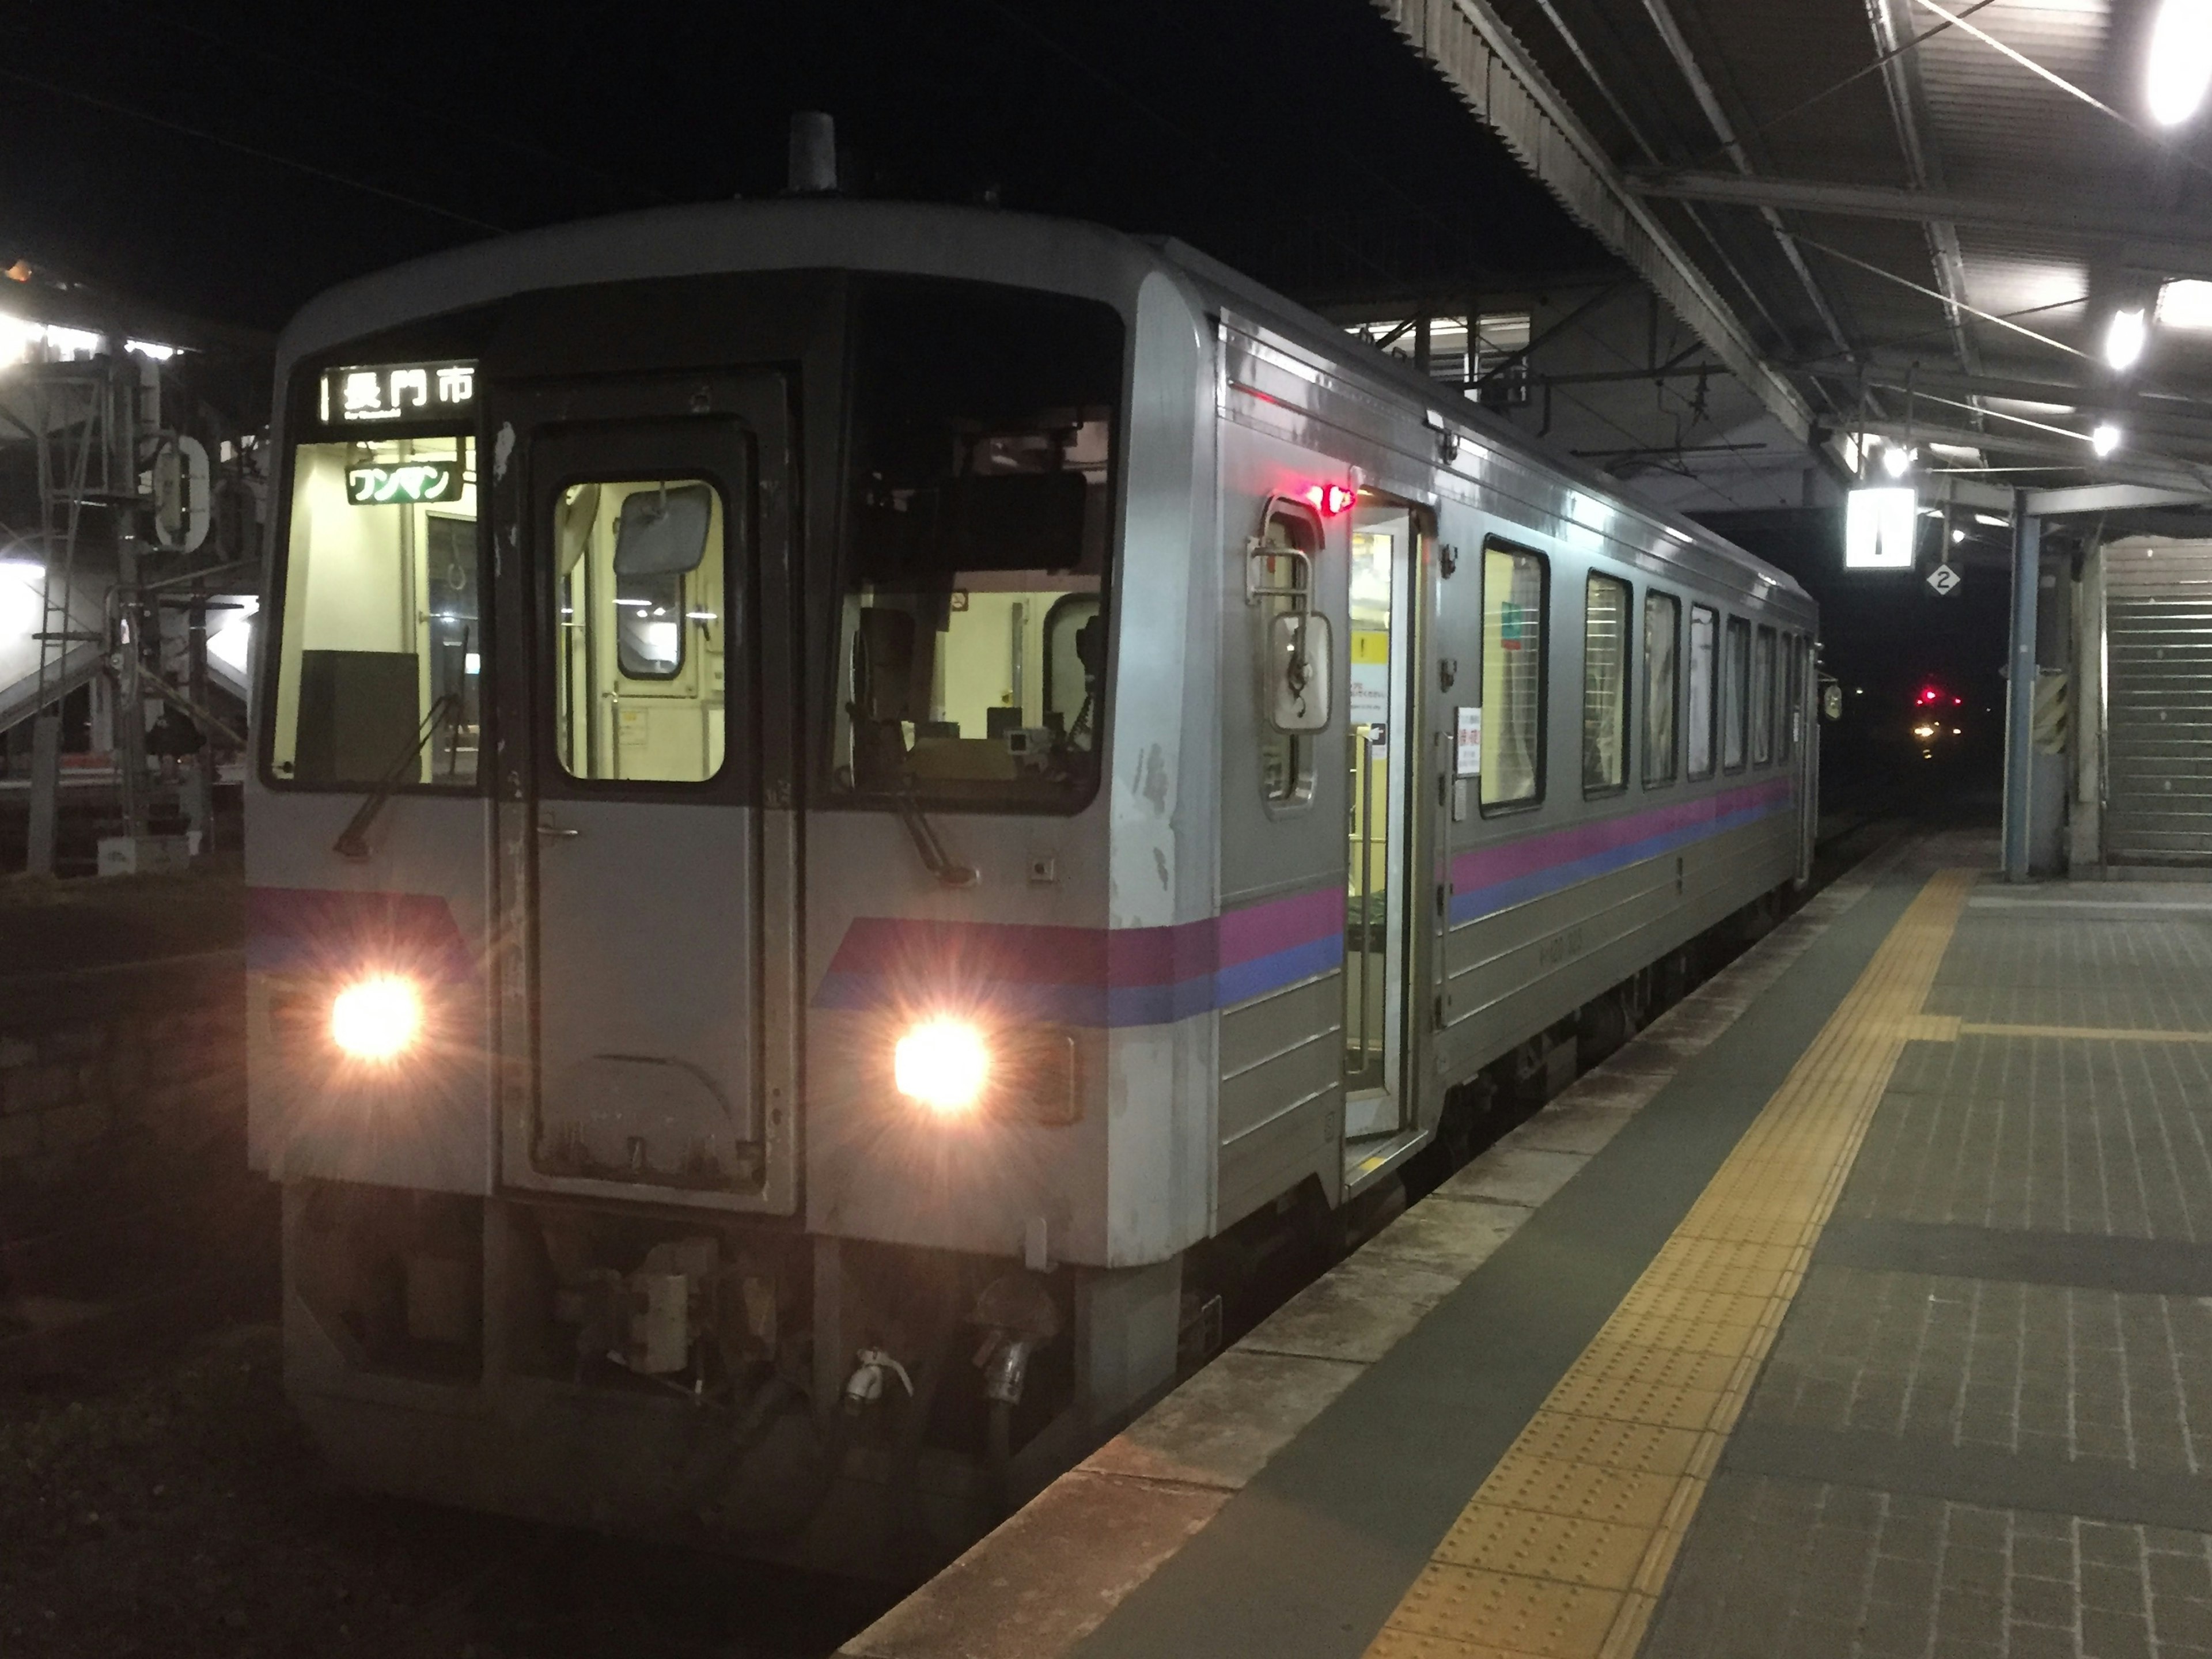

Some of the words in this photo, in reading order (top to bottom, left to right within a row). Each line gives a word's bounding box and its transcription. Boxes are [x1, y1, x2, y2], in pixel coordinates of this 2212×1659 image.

[349, 465, 449, 501] ワンマン
[1937, 571, 1950, 588] 2
